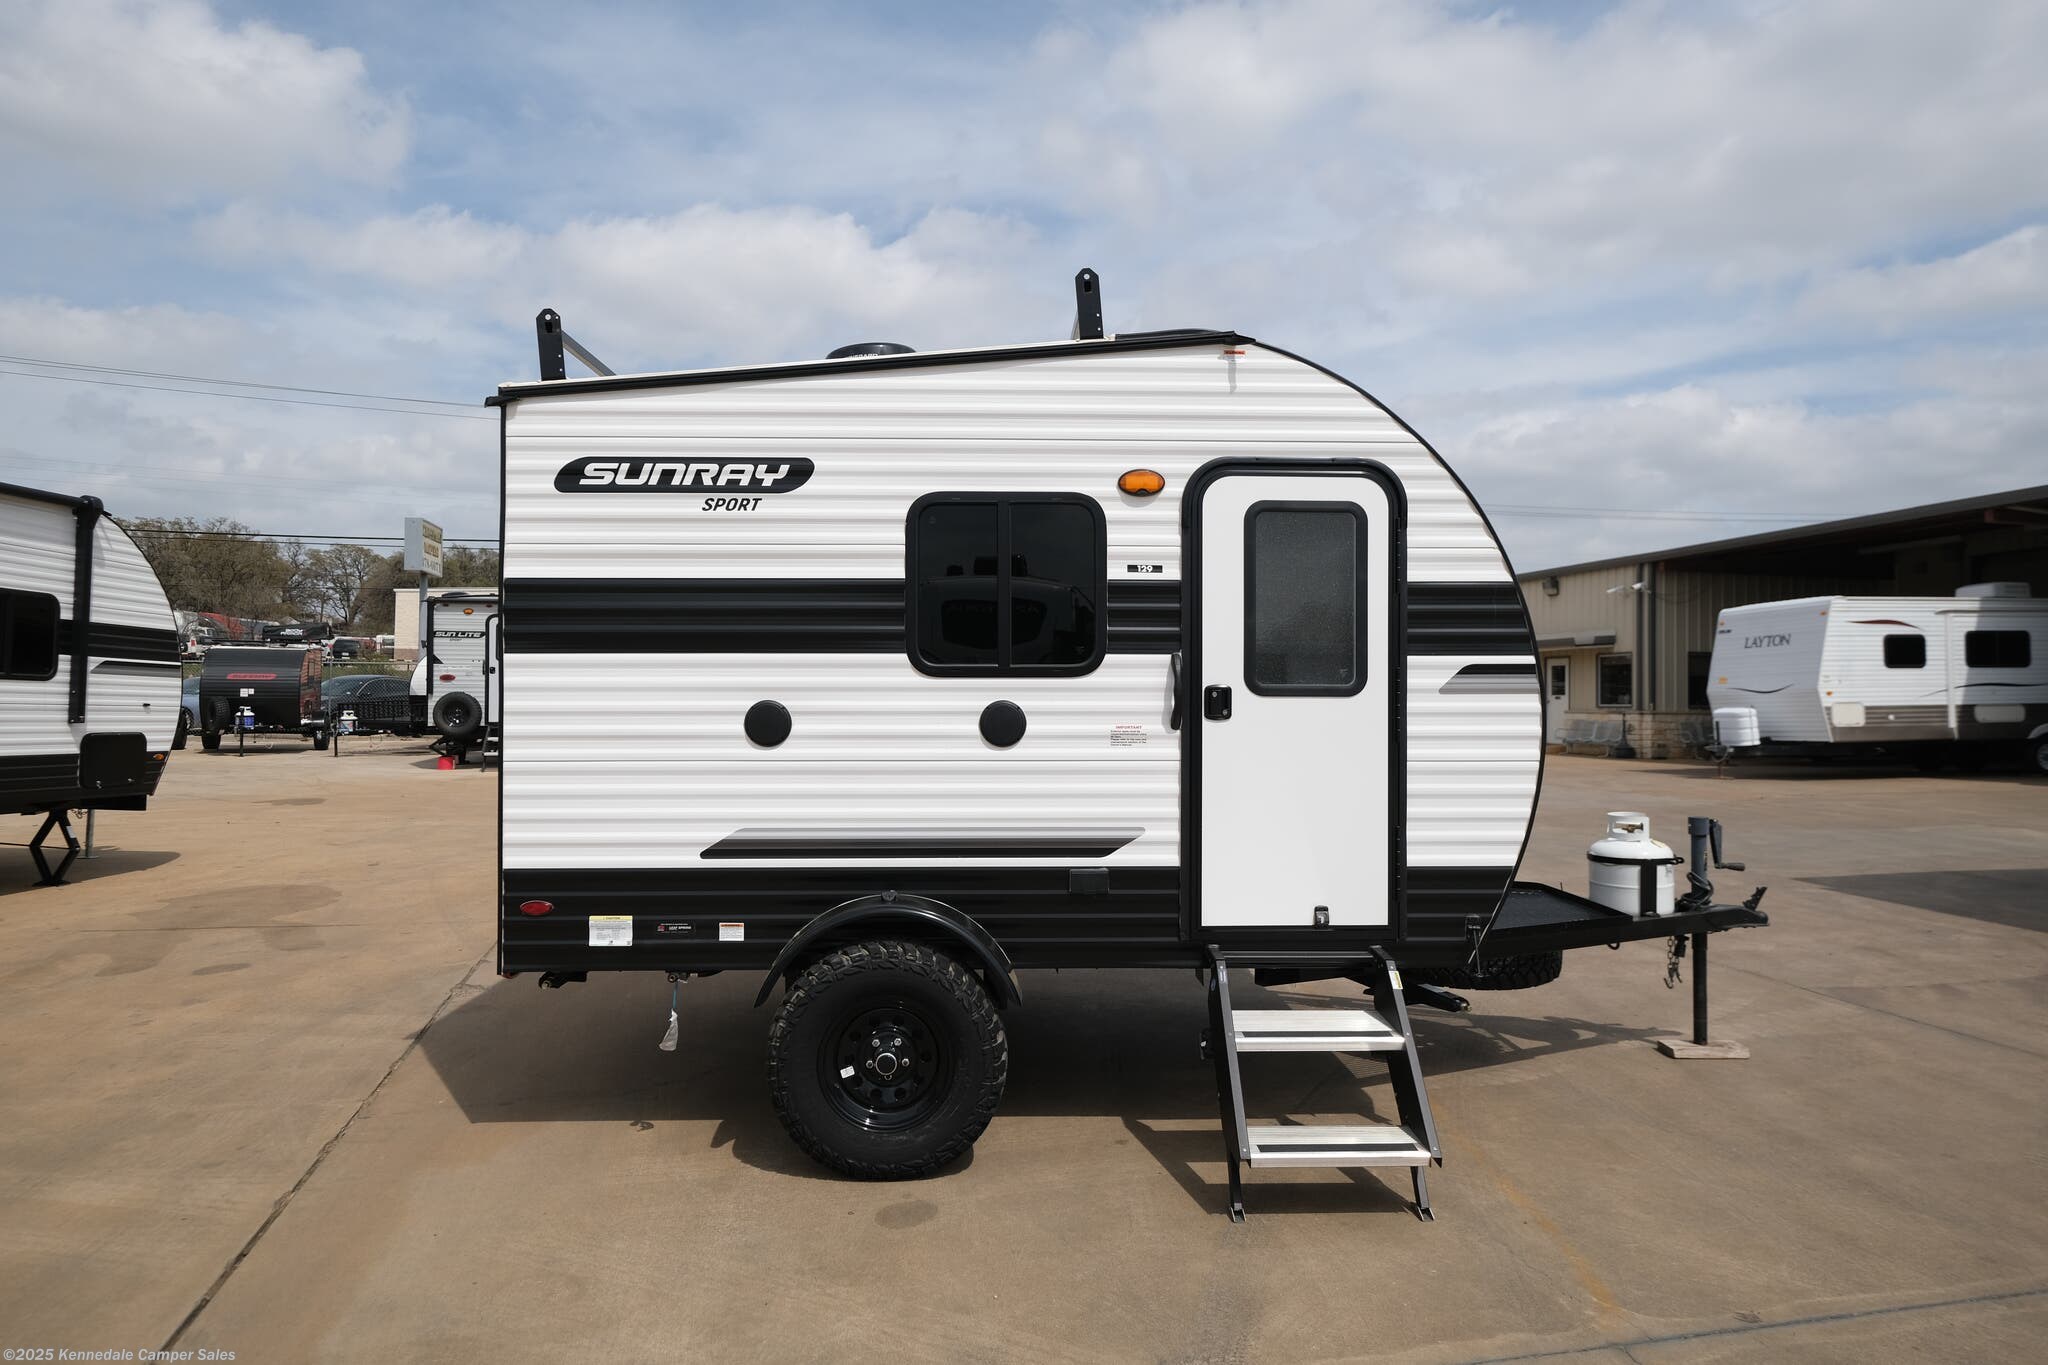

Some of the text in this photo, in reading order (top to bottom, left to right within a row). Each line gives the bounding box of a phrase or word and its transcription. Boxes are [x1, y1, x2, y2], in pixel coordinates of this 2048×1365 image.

[579, 462, 790, 487] SUNRAY
[702, 497, 762, 512] SPORT
[1137, 565, 1153, 573] 129
[1744, 633, 1791, 649] LAYTON
